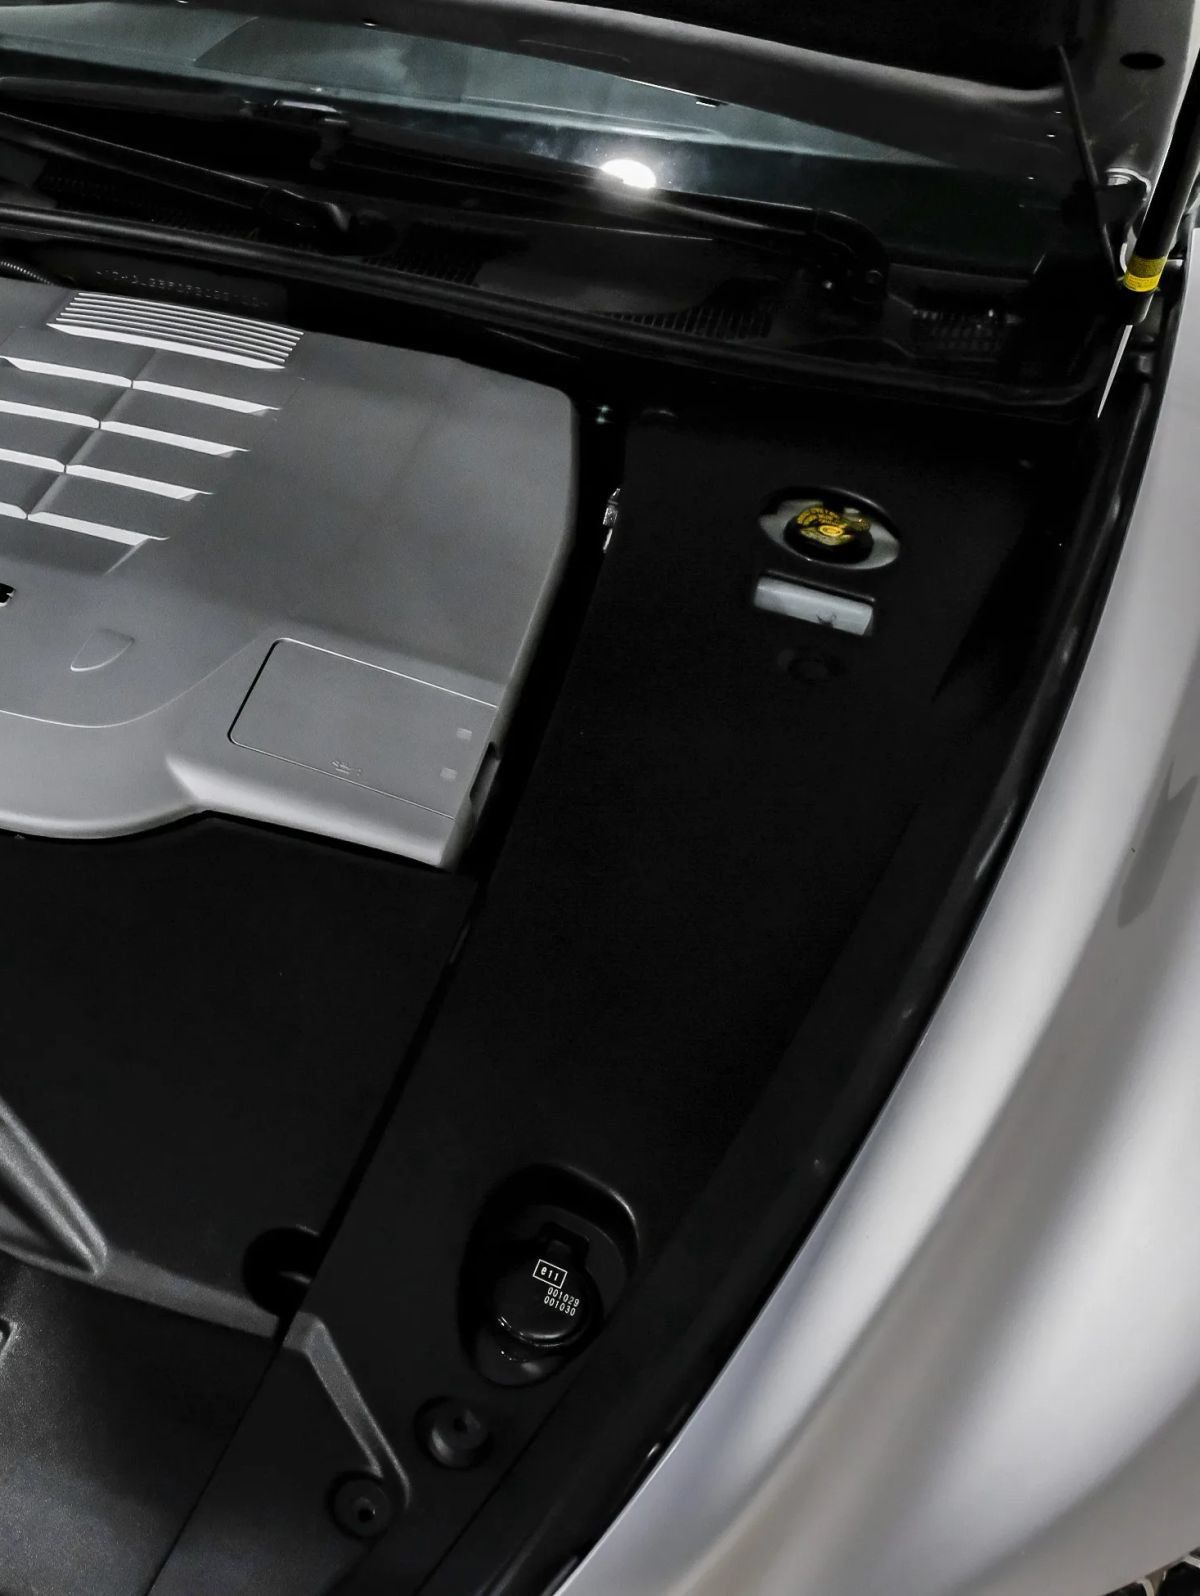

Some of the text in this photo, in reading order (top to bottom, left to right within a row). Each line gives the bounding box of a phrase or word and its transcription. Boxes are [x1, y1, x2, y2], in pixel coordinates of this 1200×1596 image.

[540, 1266, 559, 1281] e11
[544, 1296, 576, 1316] 001030
[547, 1287, 580, 1307] 001029
